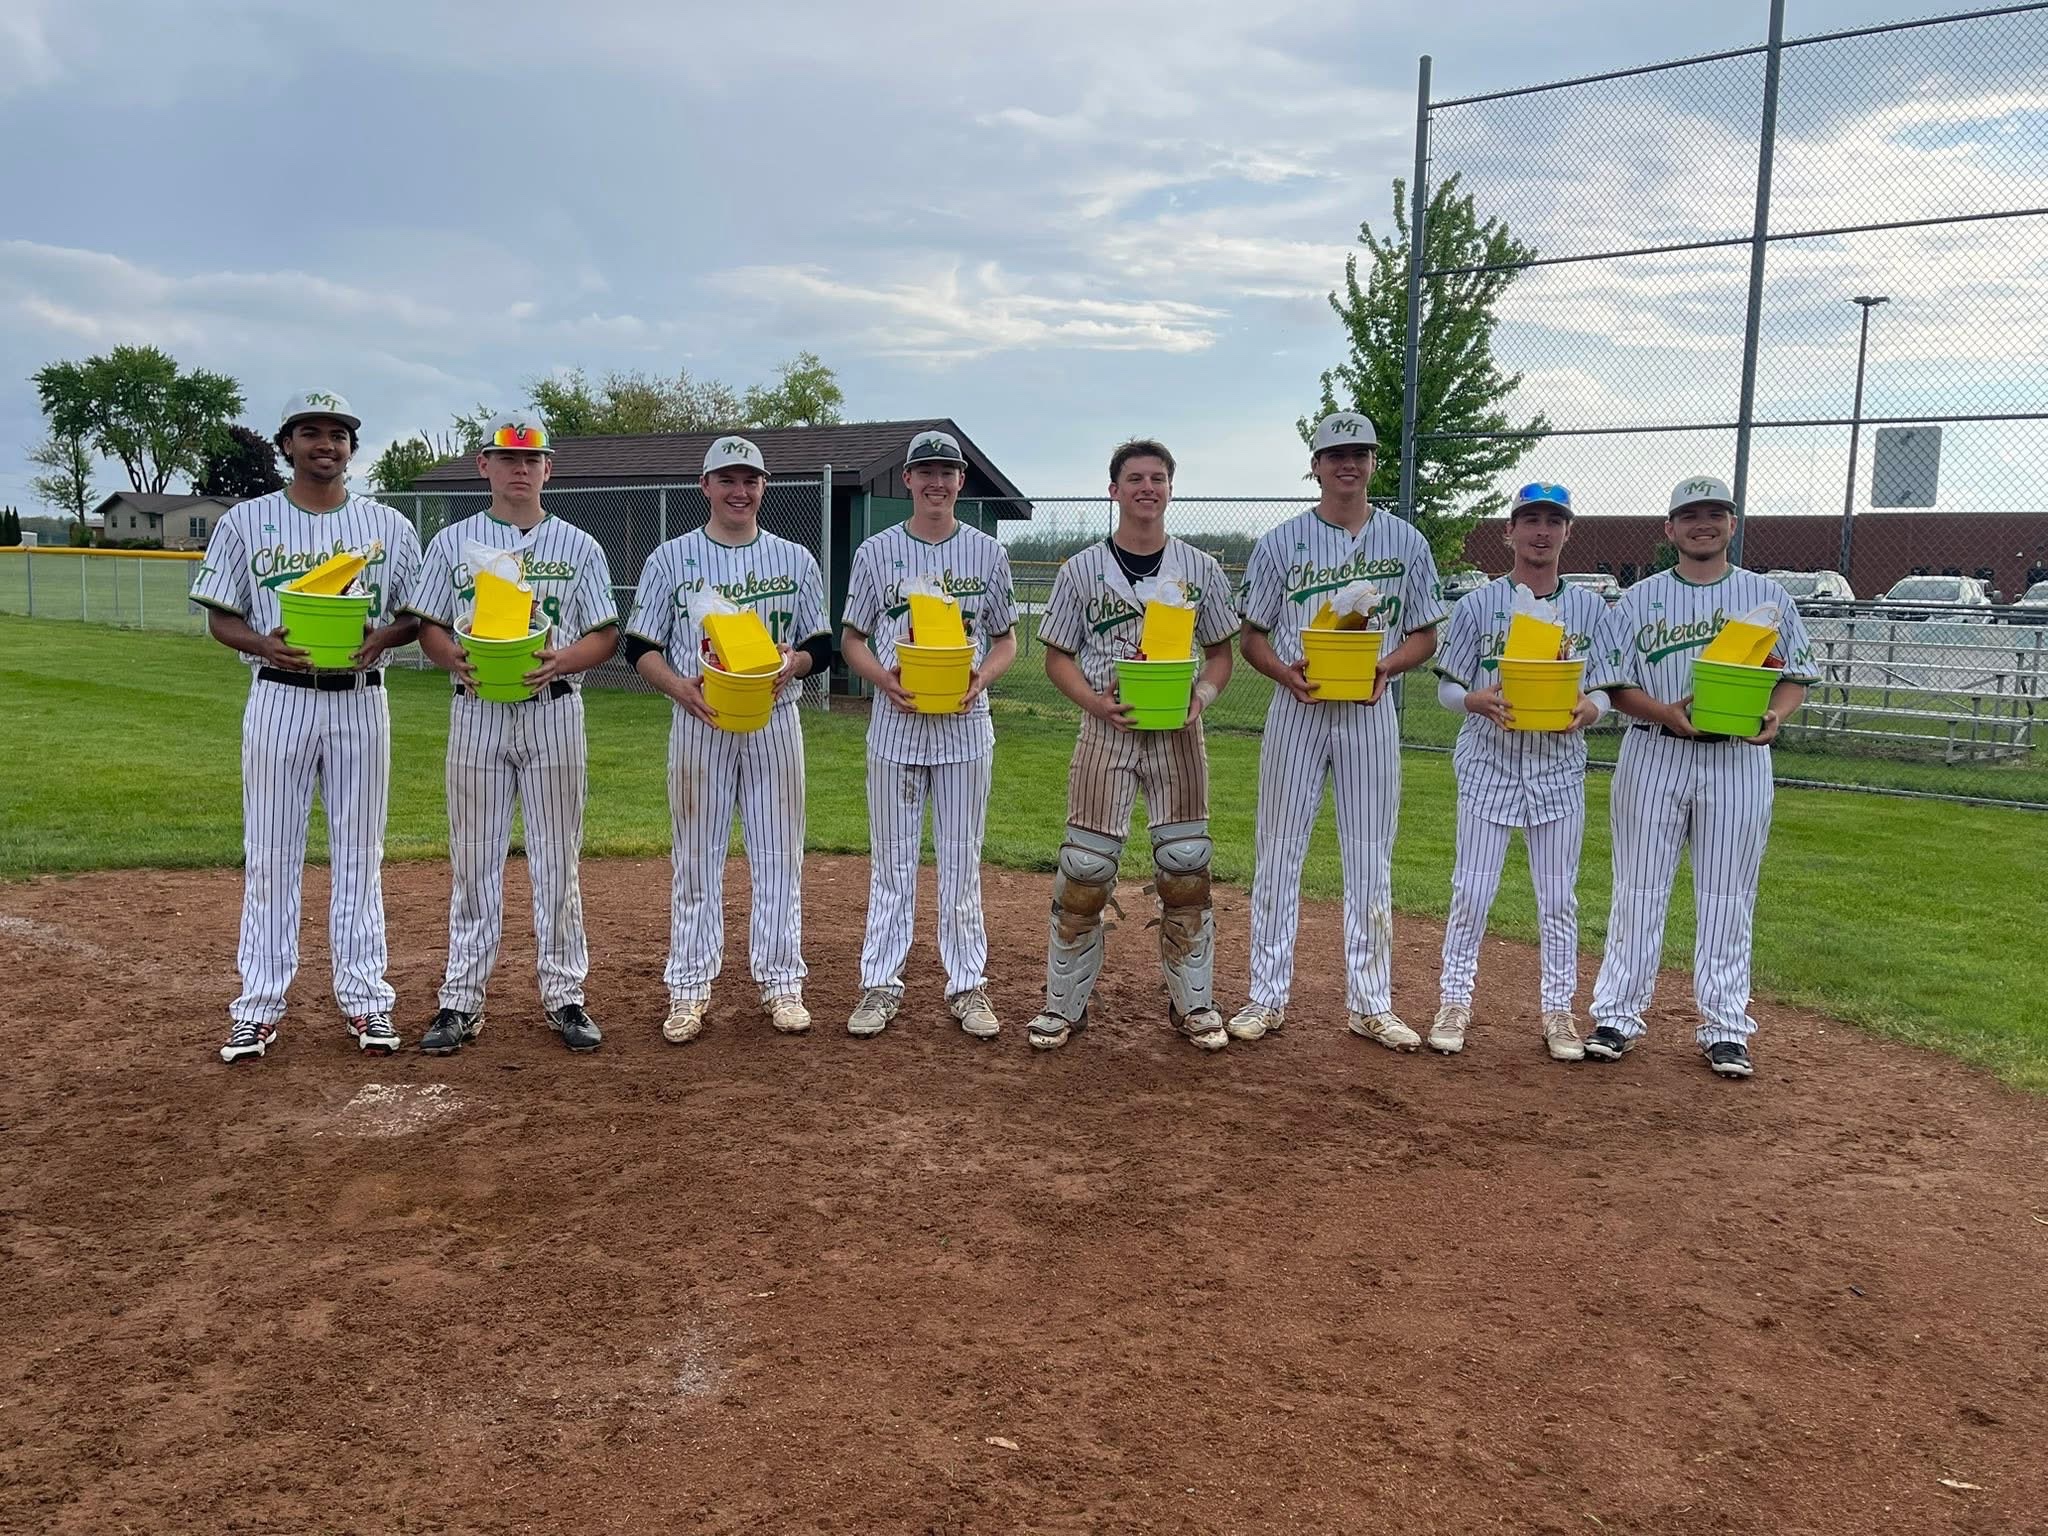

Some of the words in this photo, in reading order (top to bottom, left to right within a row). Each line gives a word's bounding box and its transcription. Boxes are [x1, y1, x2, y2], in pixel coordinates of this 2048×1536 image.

[305, 393, 341, 411] MT
[1331, 419, 1362, 436] MT
[721, 441, 753, 459] MT
[1684, 480, 1717, 497] MT
[251, 539, 383, 577] Cherok
[1286, 551, 1399, 592] Cherokees
[769, 610, 793, 644] 17
[1636, 607, 1729, 653] Cherok
